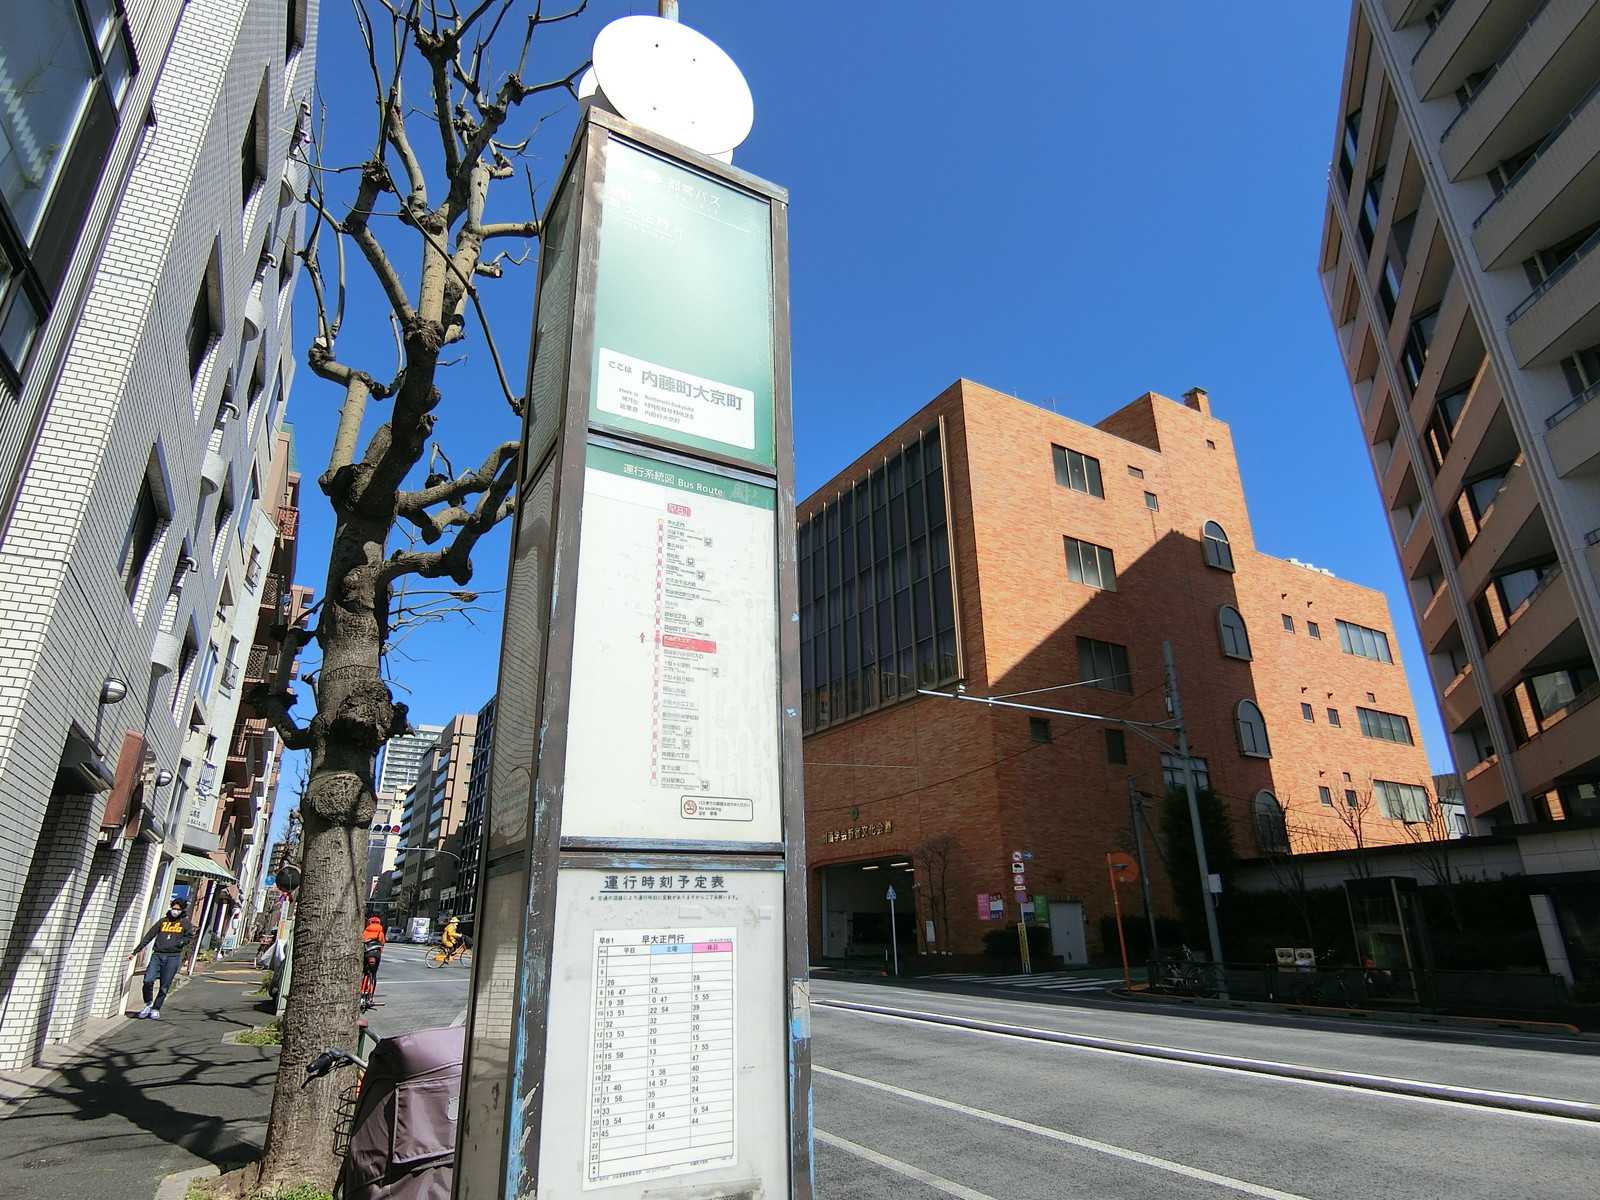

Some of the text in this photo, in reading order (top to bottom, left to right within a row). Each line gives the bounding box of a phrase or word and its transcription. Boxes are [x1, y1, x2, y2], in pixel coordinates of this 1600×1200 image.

[608, 360, 743, 411] ここは 内藤町大京町
[623, 463, 724, 496] 運行系統図 Bus Route
[604, 875, 725, 890] 運行時刻予定表
[642, 934, 685, 945] 早大正門行
